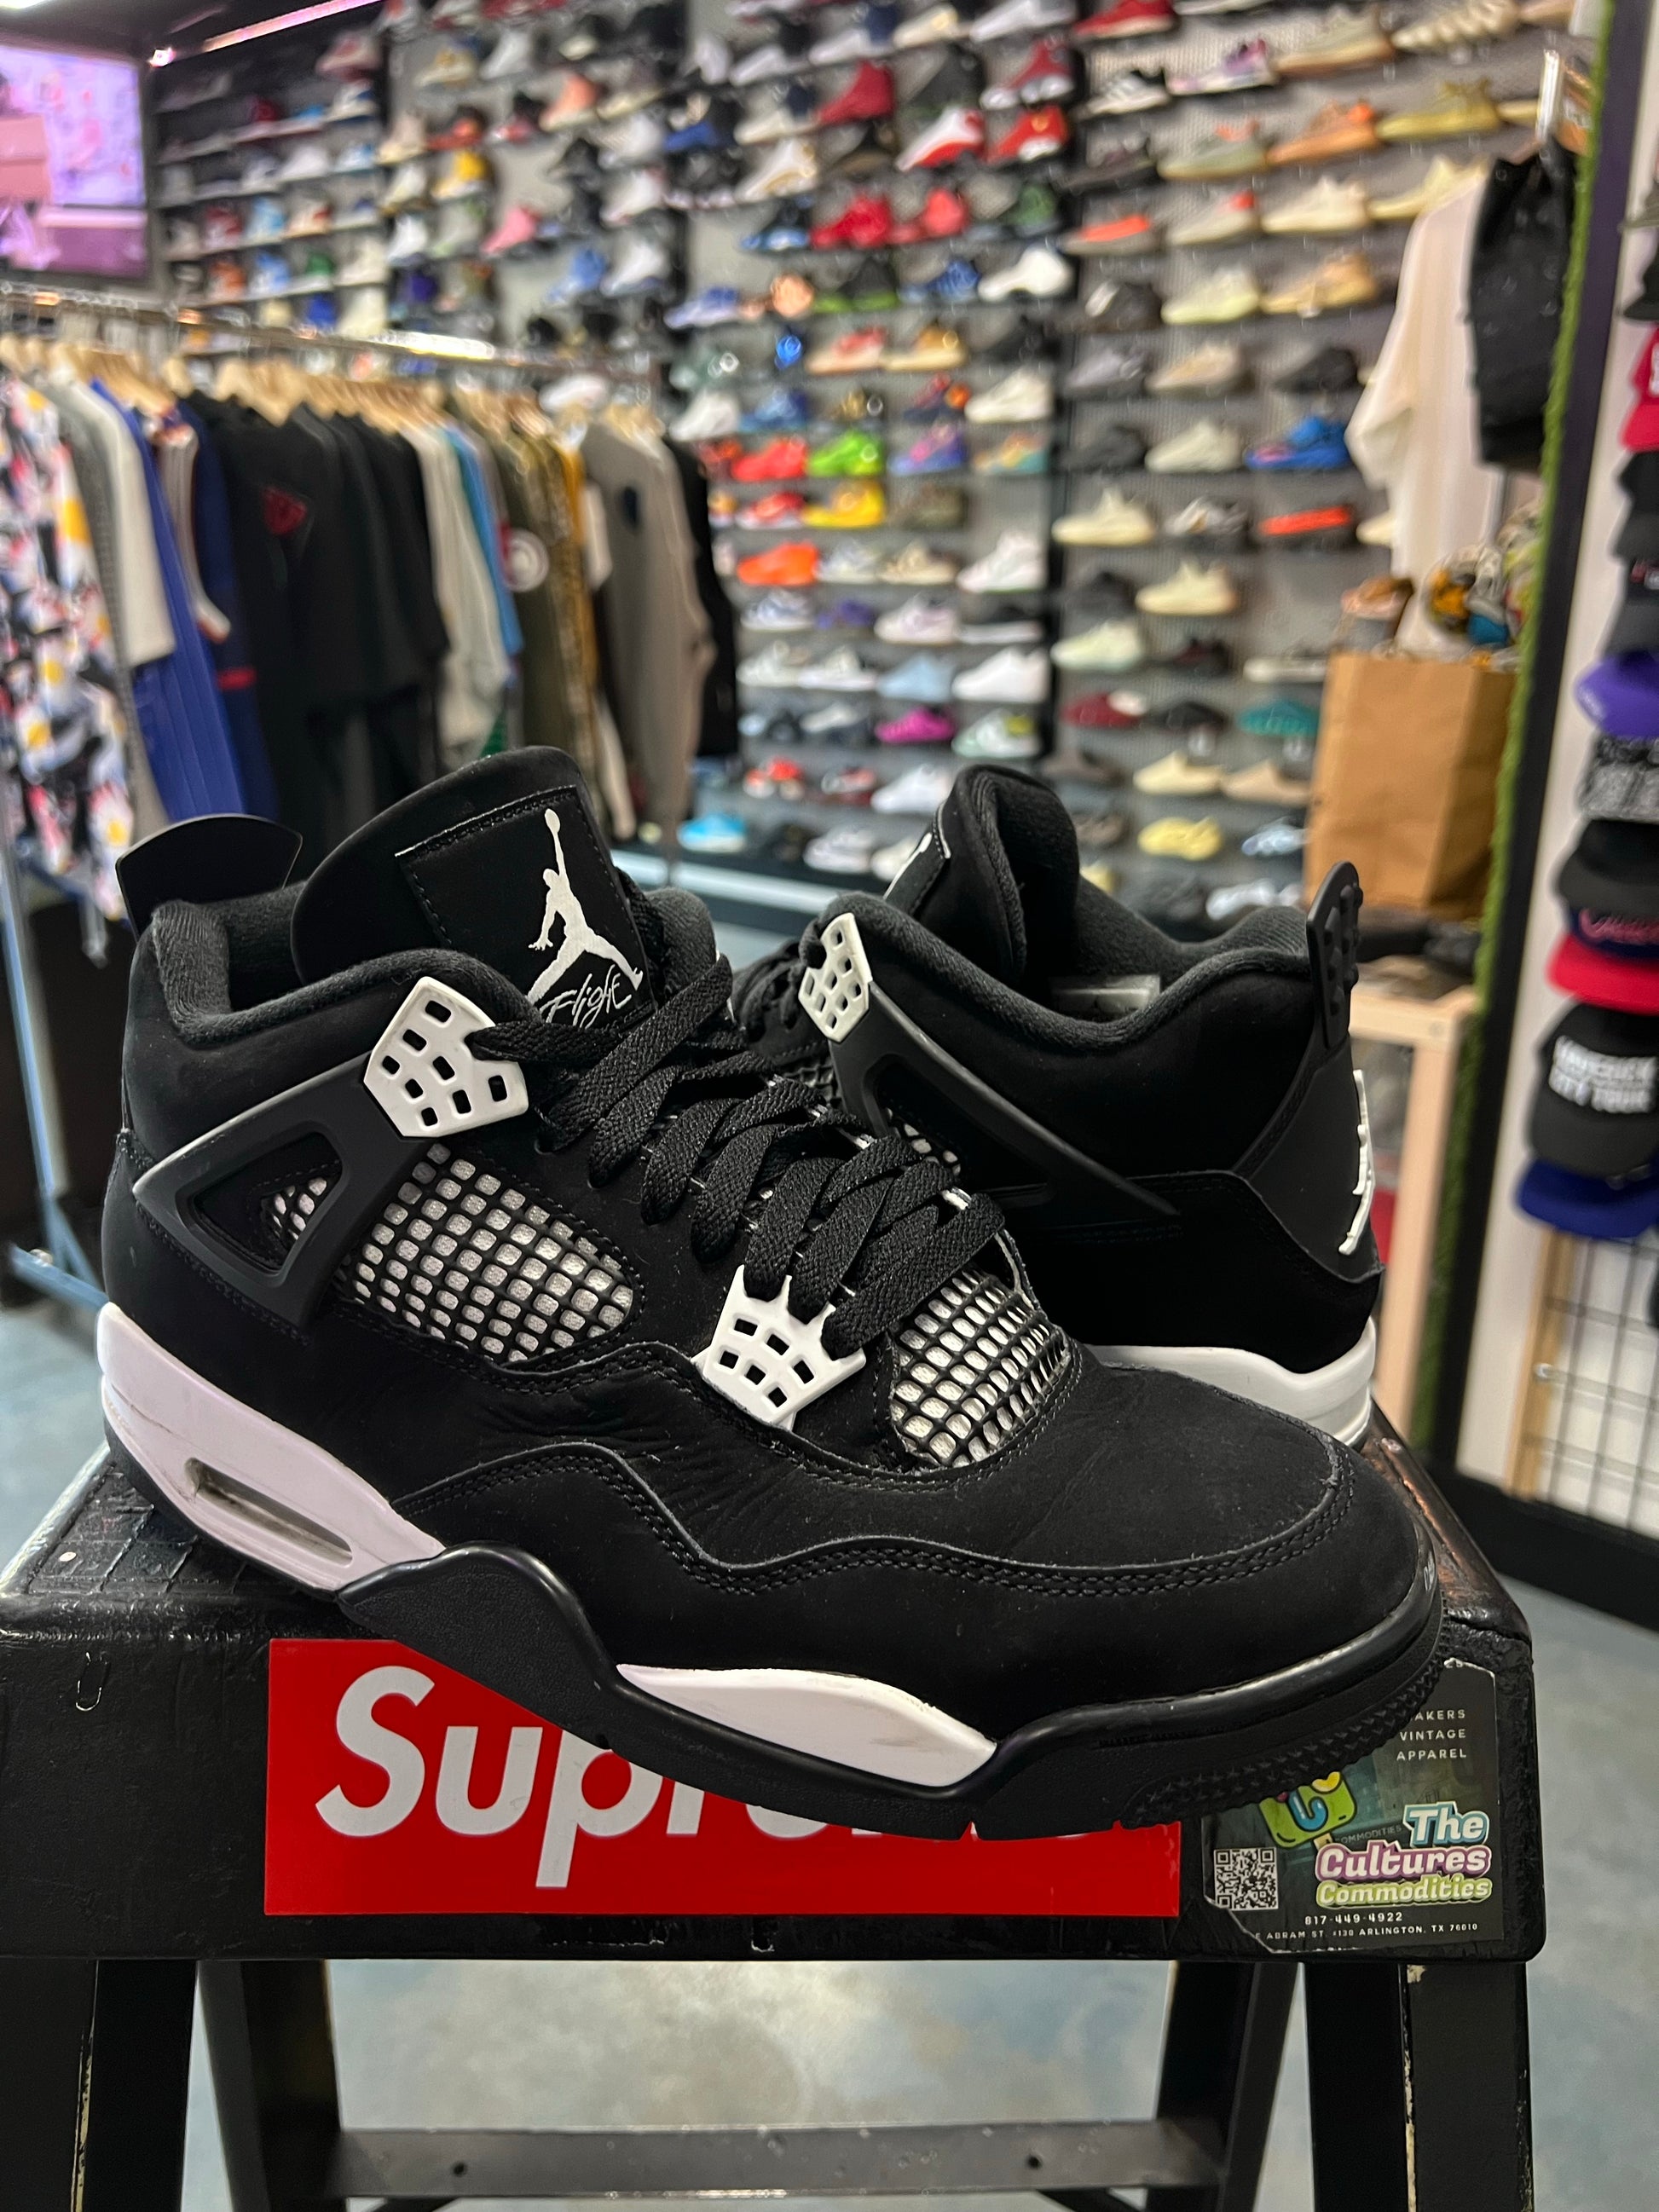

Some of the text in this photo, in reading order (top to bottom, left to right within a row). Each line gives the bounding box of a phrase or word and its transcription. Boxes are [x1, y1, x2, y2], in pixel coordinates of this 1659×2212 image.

[1412, 1709, 1465, 1721] AKERS
[1399, 1729, 1466, 1741] VINTAGE
[1396, 1748, 1467, 1761] APPAREL
[1408, 1805, 1486, 1844] The
[1318, 1843, 1488, 1880] Cultures
[1318, 1874, 1491, 1906] Commodities
[1304, 1911, 1403, 1926] 817-449-4922
[1266, 1931, 1306, 1939] ABRAM
[1431, 1924, 1444, 1933] TX
[1449, 1923, 1478, 1932] 76010
